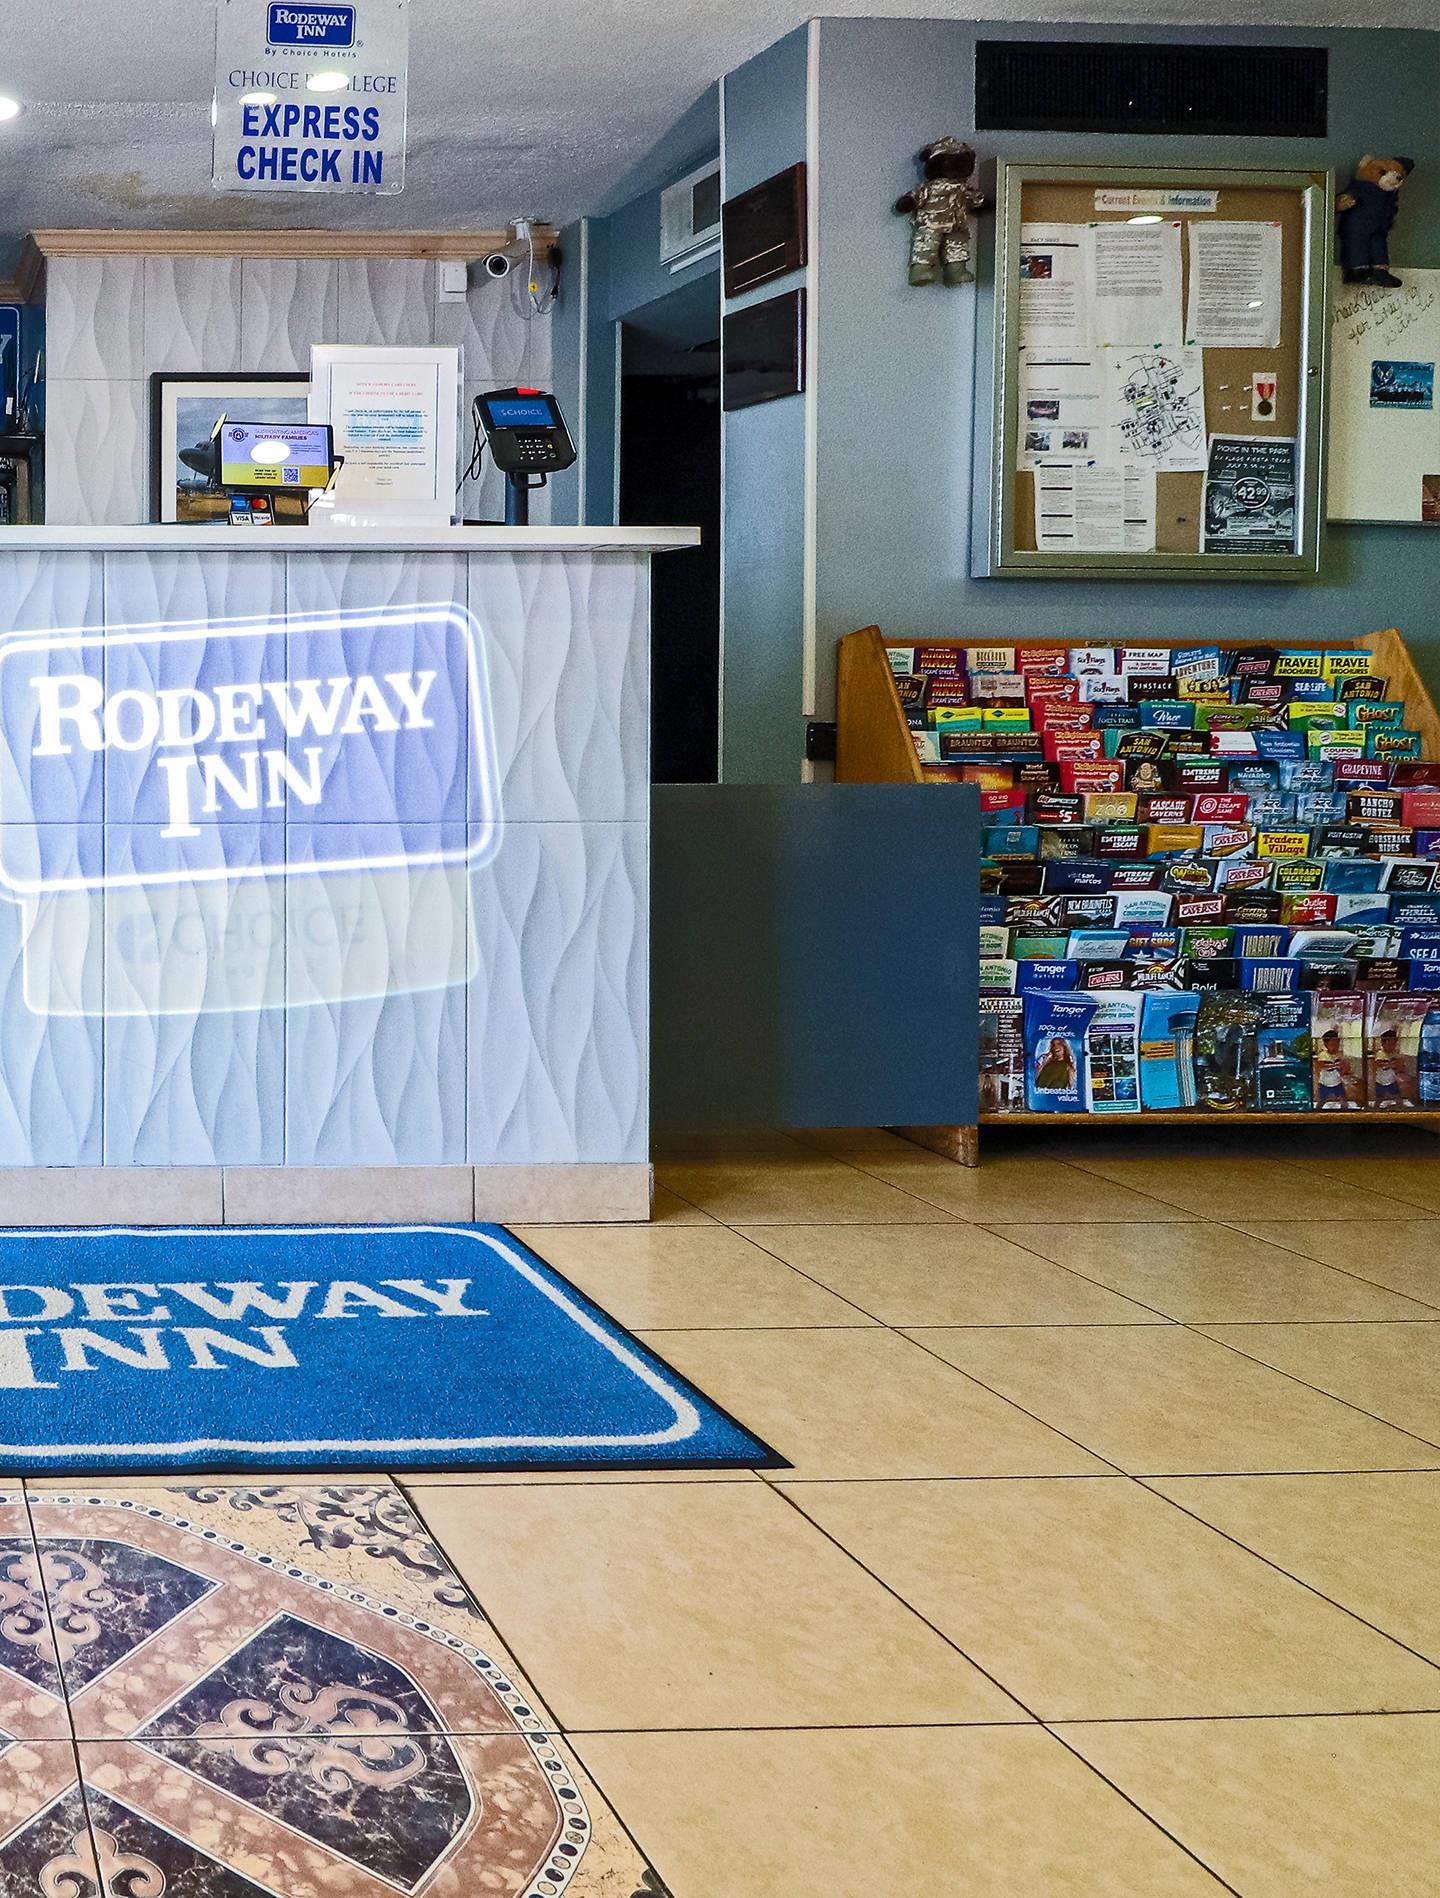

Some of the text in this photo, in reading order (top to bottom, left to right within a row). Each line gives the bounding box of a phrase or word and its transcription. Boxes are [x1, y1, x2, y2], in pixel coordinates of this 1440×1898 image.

[275, 8, 348, 26] RODEWAY
[296, 24, 327, 39] INN
[265, 47, 357, 58] By Choice Hotels
[228, 69, 397, 94] CHOICE PLEGE
[242, 103, 380, 142] EXPRESS
[237, 145, 383, 184] CHECK IN
[1102, 194, 1211, 206] Current Information
[1216, 445, 1240, 454] PICNIC
[1268, 447, 1289, 455] PARK
[1278, 657, 1320, 668] TRAVEL
[1329, 657, 1370, 668] TRAVEL
[1175, 659, 1217, 677] ADVENTURE
[1294, 682, 1327, 692] SEA LIFE
[1355, 682, 1371, 690] SAN
[1343, 689, 1380, 699] ANTONIO
[29, 670, 438, 757] RODEWAY
[1355, 704, 1400, 722] GHOST
[950, 739, 993, 747] BRAUNTEX
[996, 738, 1040, 747] BRAUNTEX
[1133, 738, 1151, 746] SAN
[1374, 733, 1417, 751] GHOST
[1120, 745, 1158, 755] ANTONIO
[1182, 768, 1221, 776] EXTREME
[1342, 764, 1383, 776] GRAPEVINE
[156, 746, 324, 839] INN
[1150, 800, 1187, 810] CASCADE
[1360, 797, 1394, 808] RANCHO
[1149, 810, 1184, 818] CAVERNS
[1361, 807, 1392, 818] CORTEZ
[1100, 835, 1139, 843] EXTREME
[1262, 834, 1303, 844] Traders
[1343, 832, 1364, 840] AUSTIN
[1368, 834, 1411, 844] HORSEBACK
[1268, 844, 1305, 855] Village
[1378, 843, 1401, 853] RIDES
[1278, 866, 1321, 876] COLORADO
[1281, 875, 1317, 883] VACATION
[1067, 899, 1114, 911] NEW BRAUNFELS
[1124, 900, 1167, 910] SAN ANTONIO
[1302, 897, 1327, 907] Outlet
[1129, 937, 1176, 948] GIFT SHOP
[1033, 963, 1067, 974] Tanger
[1191, 983, 1217, 991] Bold
[1052, 1005, 1087, 1014] Tanger
[1107, 1003, 1137, 1012] ANTONIO
[1033, 1087, 1078, 1095] Unbeatable
